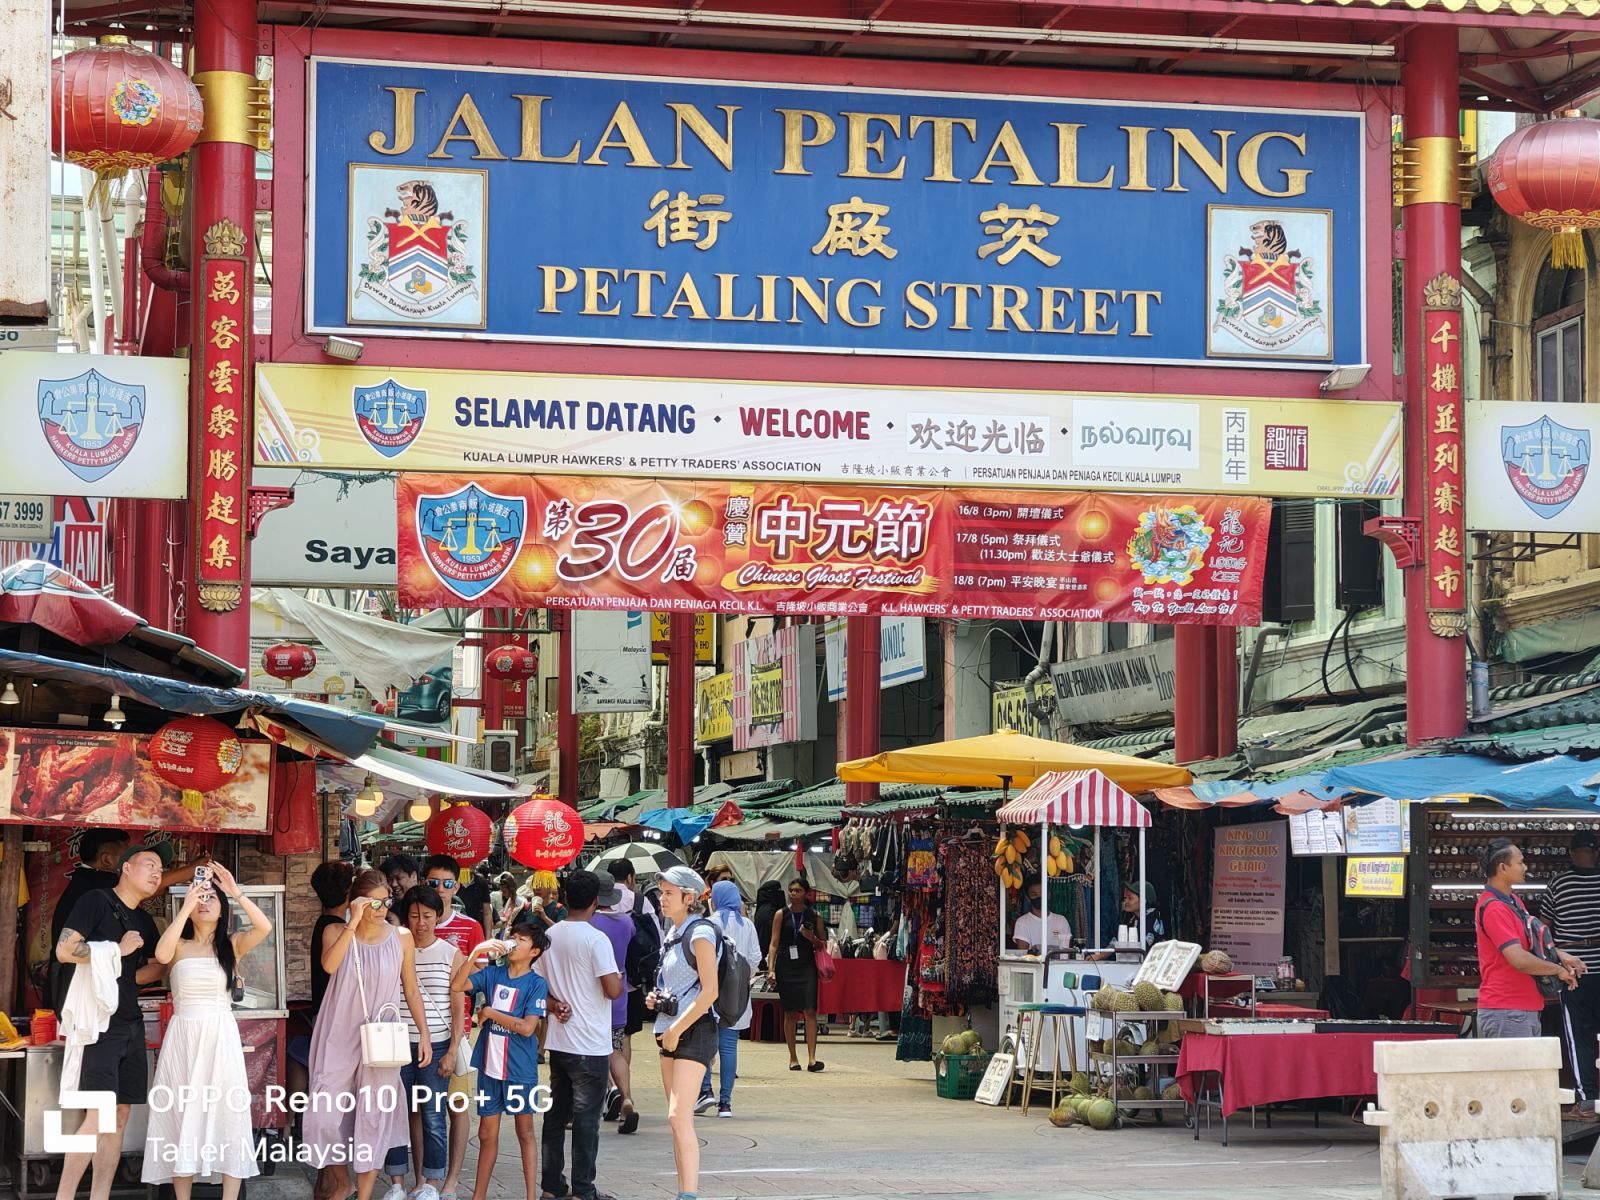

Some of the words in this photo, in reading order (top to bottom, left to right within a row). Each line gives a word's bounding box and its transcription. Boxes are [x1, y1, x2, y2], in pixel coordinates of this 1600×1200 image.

[368, 86, 743, 171] JALAN
[774, 108, 1313, 197] PETALING
[364, 282, 388, 300] Dewan
[388, 296, 425, 315] Bandaraya
[427, 300, 447, 312] Kuala
[447, 283, 472, 302] Lumpur
[537, 265, 885, 327] PETALING
[905, 280, 1161, 337] STREET
[455, 397, 580, 431] SELAMAT
[586, 401, 696, 434] DATANG
[739, 406, 870, 440] WELCOME
[909, 416, 1045, 455] 欢迎光临
[1080, 421, 1192, 452] நல்வரவு
[66, 442, 88, 457] KUALA
[90, 444, 119, 458] LUMPUR
[1225, 411, 1247, 481] 丙申年
[463, 451, 504, 463] KUALA
[508, 452, 558, 464] LUMPUR
[628, 456, 638, 467] &
[640, 457, 678, 468] PETTY
[743, 460, 821, 472] ASSOCIATION
[972, 467, 1017, 479] PERSATUAN
[1018, 468, 1051, 480] PENJAJA
[1052, 469, 1067, 480] DAN
[1069, 470, 1101, 482] PENIAGA
[1103, 471, 1123, 482] KECIL
[1125, 471, 1150, 483] KUALA
[1151, 472, 1181, 484] LUMPUR
[14, 501, 44, 521] 3999
[958, 505, 978, 516] 16/8
[983, 507, 1012, 518] (3pm)
[757, 497, 928, 561] 中元節
[956, 533, 977, 544] 17/8
[980, 534, 1008, 545] (5pm)
[64, 530, 100, 581] JAM
[305, 539, 396, 570] Saya
[446, 557, 467, 572] KUALA
[470, 558, 497, 572] LUMPUR
[462, 555, 480, 563] 1953
[980, 549, 1027, 561] (11.30pm)
[458, 572, 478, 580] PETTY
[738, 564, 801, 585] Chinese
[804, 566, 856, 592] Ghost
[854, 566, 924, 587] Festival
[953, 575, 974, 586] 18/8
[978, 576, 1007, 588] (7pm)
[546, 596, 604, 608] PERSATUAN
[607, 597, 648, 609] PENJAJA
[650, 598, 671, 609] DAN
[674, 599, 717, 610] PENIAGA
[719, 600, 745, 611] KECIL
[747, 601, 764, 611] K.L.
[881, 603, 898, 613] K.L.
[952, 605, 959, 615] &
[961, 605, 989, 616] PETTY
[1040, 608, 1103, 620] ASSOCIATION
[1132, 600, 1150, 613] Try
[1194, 602, 1217, 613] Love
